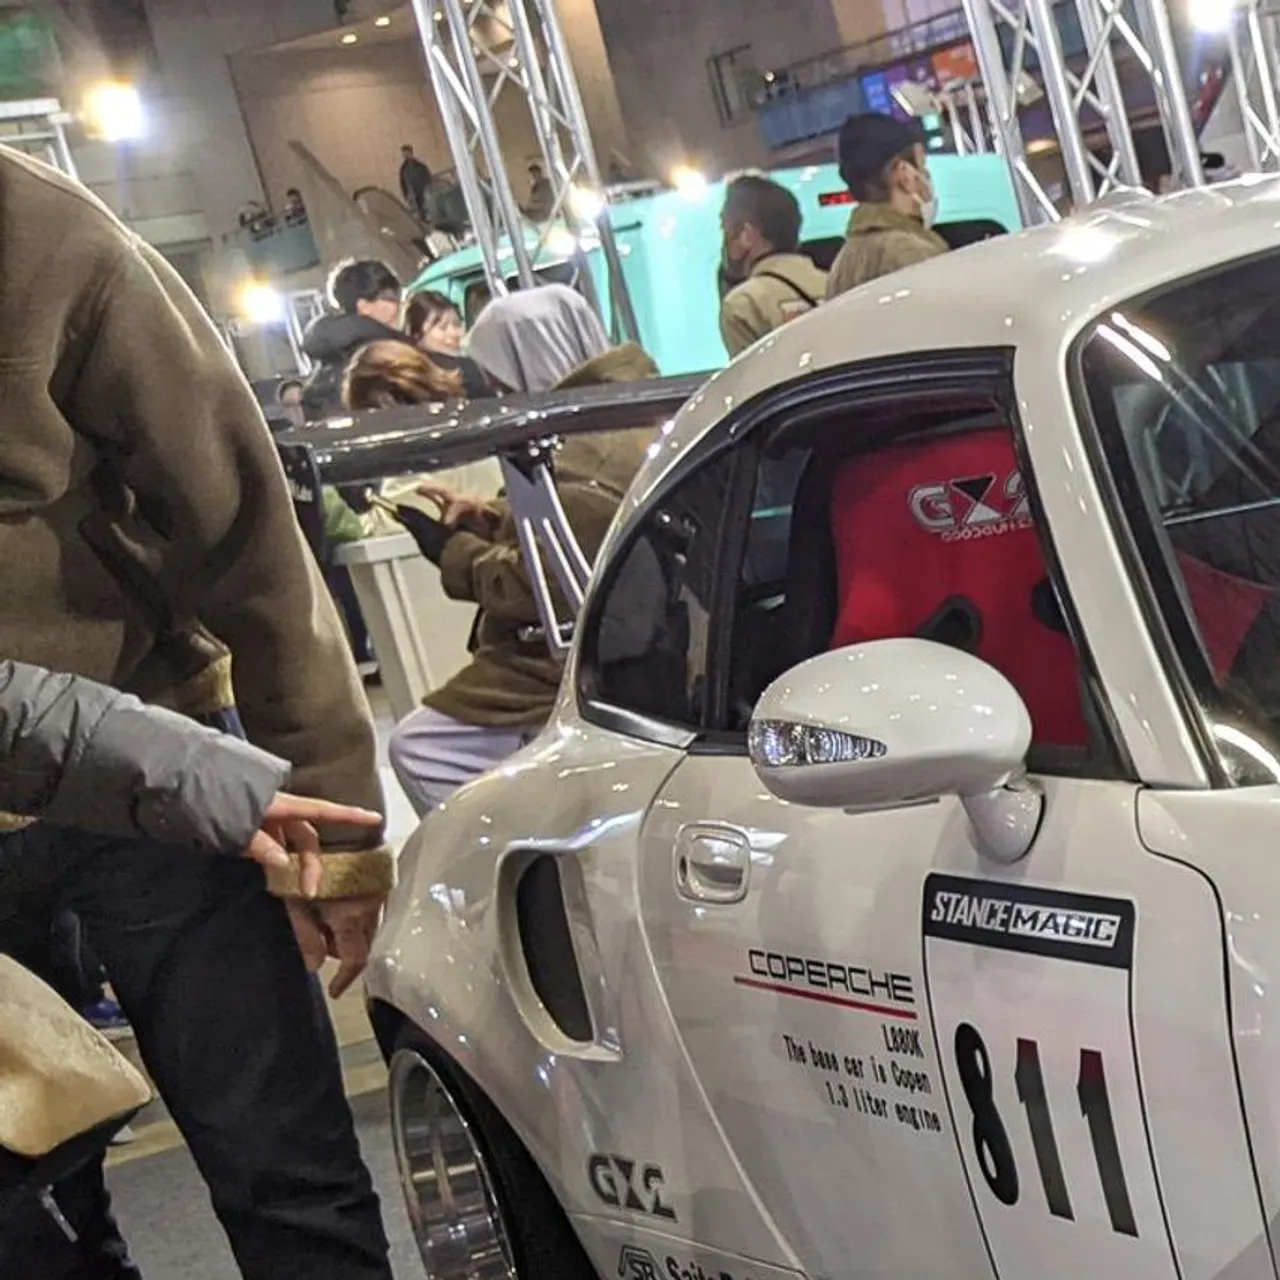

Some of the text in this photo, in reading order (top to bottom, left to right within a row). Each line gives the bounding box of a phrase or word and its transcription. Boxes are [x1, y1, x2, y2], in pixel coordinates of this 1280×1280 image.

[931, 890, 1120, 946] STANCE MAGIC
[749, 949, 915, 1003] COPERCHE
[783, 1033, 932, 1095] The base car is Copen
[826, 1081, 942, 1133] 1.3 liter engine
[954, 1021, 1140, 1239] 811
